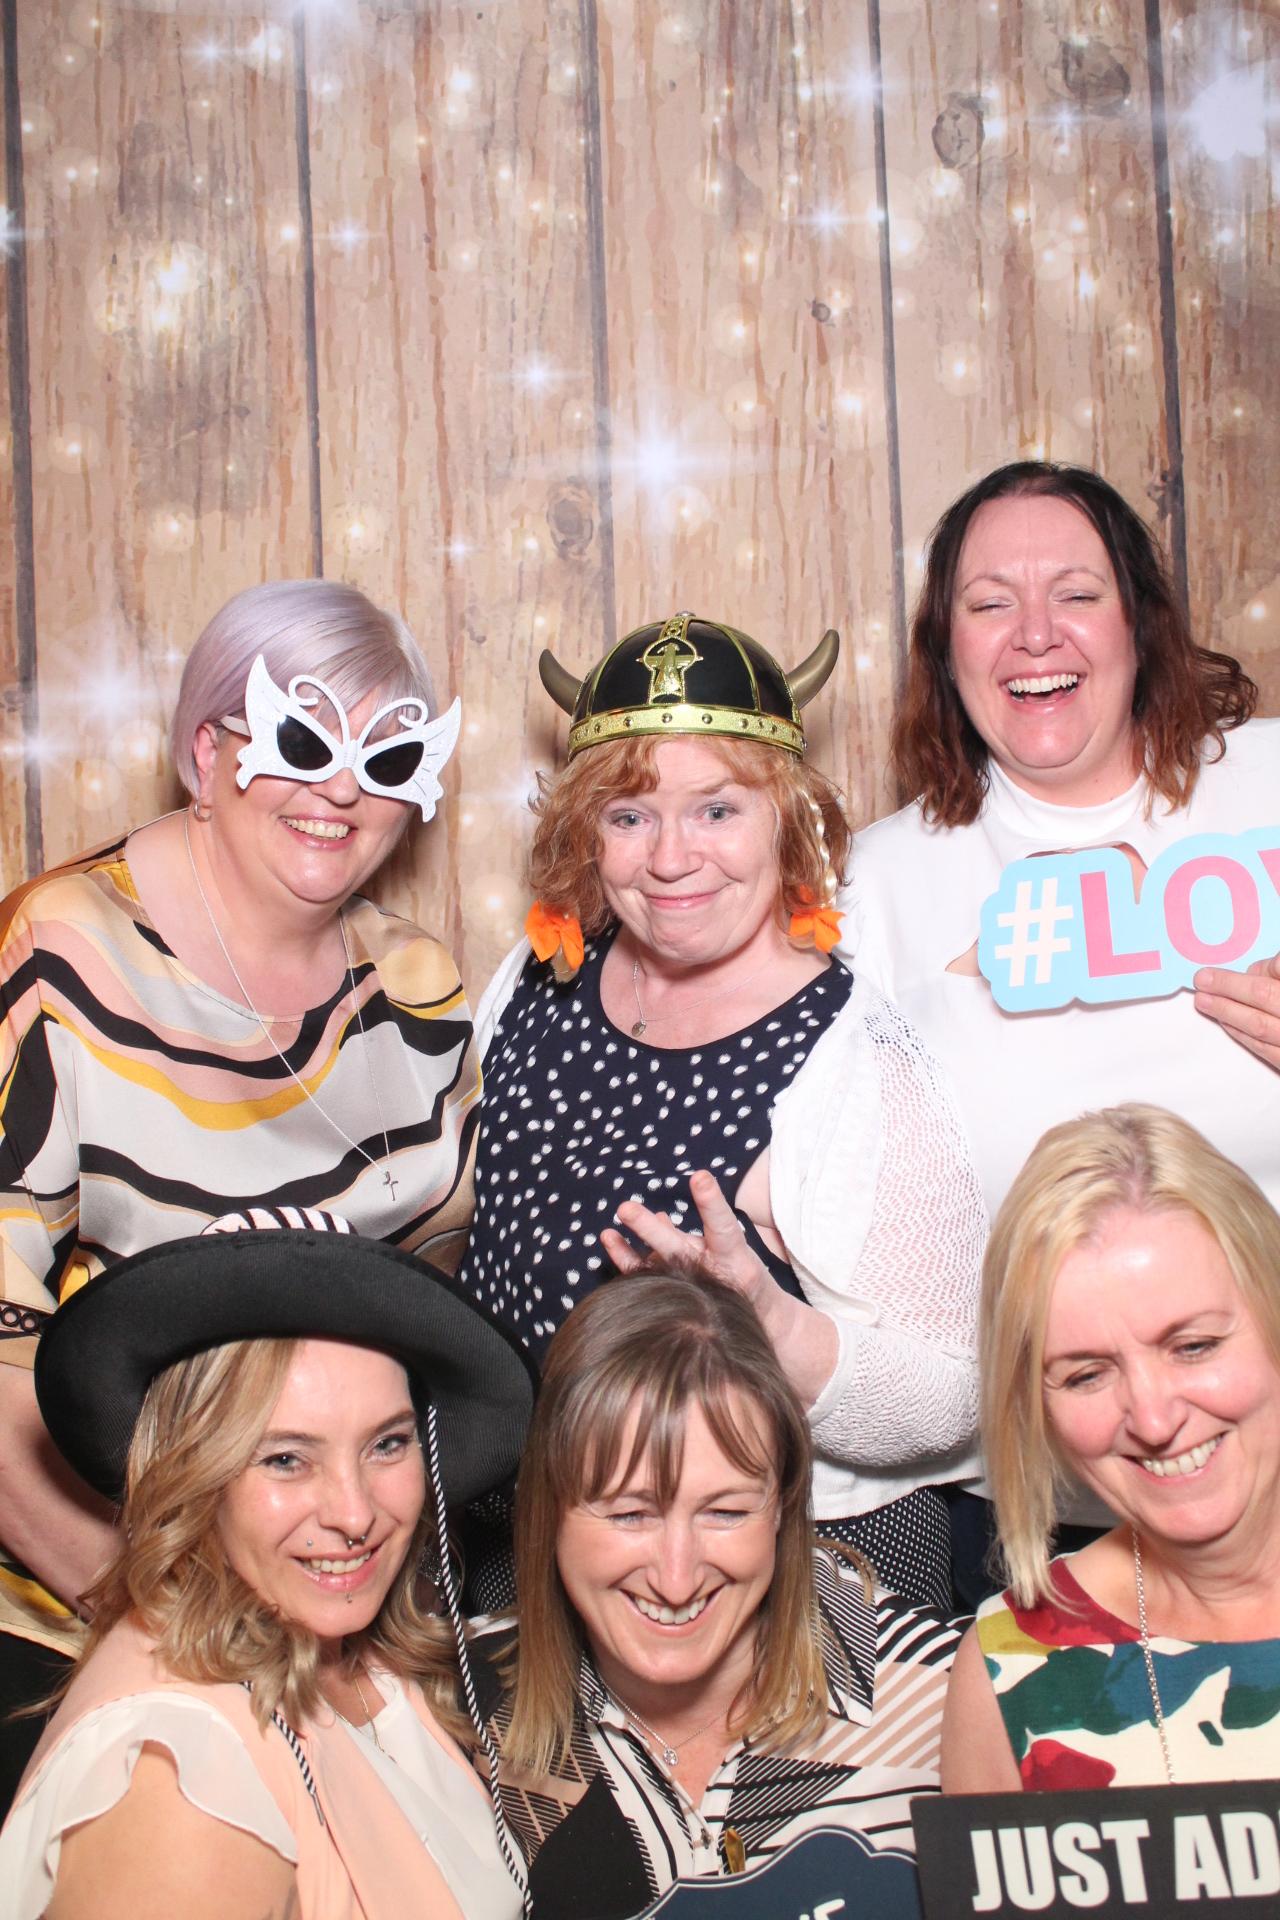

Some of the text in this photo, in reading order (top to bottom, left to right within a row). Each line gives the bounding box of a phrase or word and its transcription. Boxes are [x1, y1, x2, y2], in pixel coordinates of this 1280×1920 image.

[994, 848, 1280, 987] #LO
[970, 1810, 1280, 1912] JUST AD
